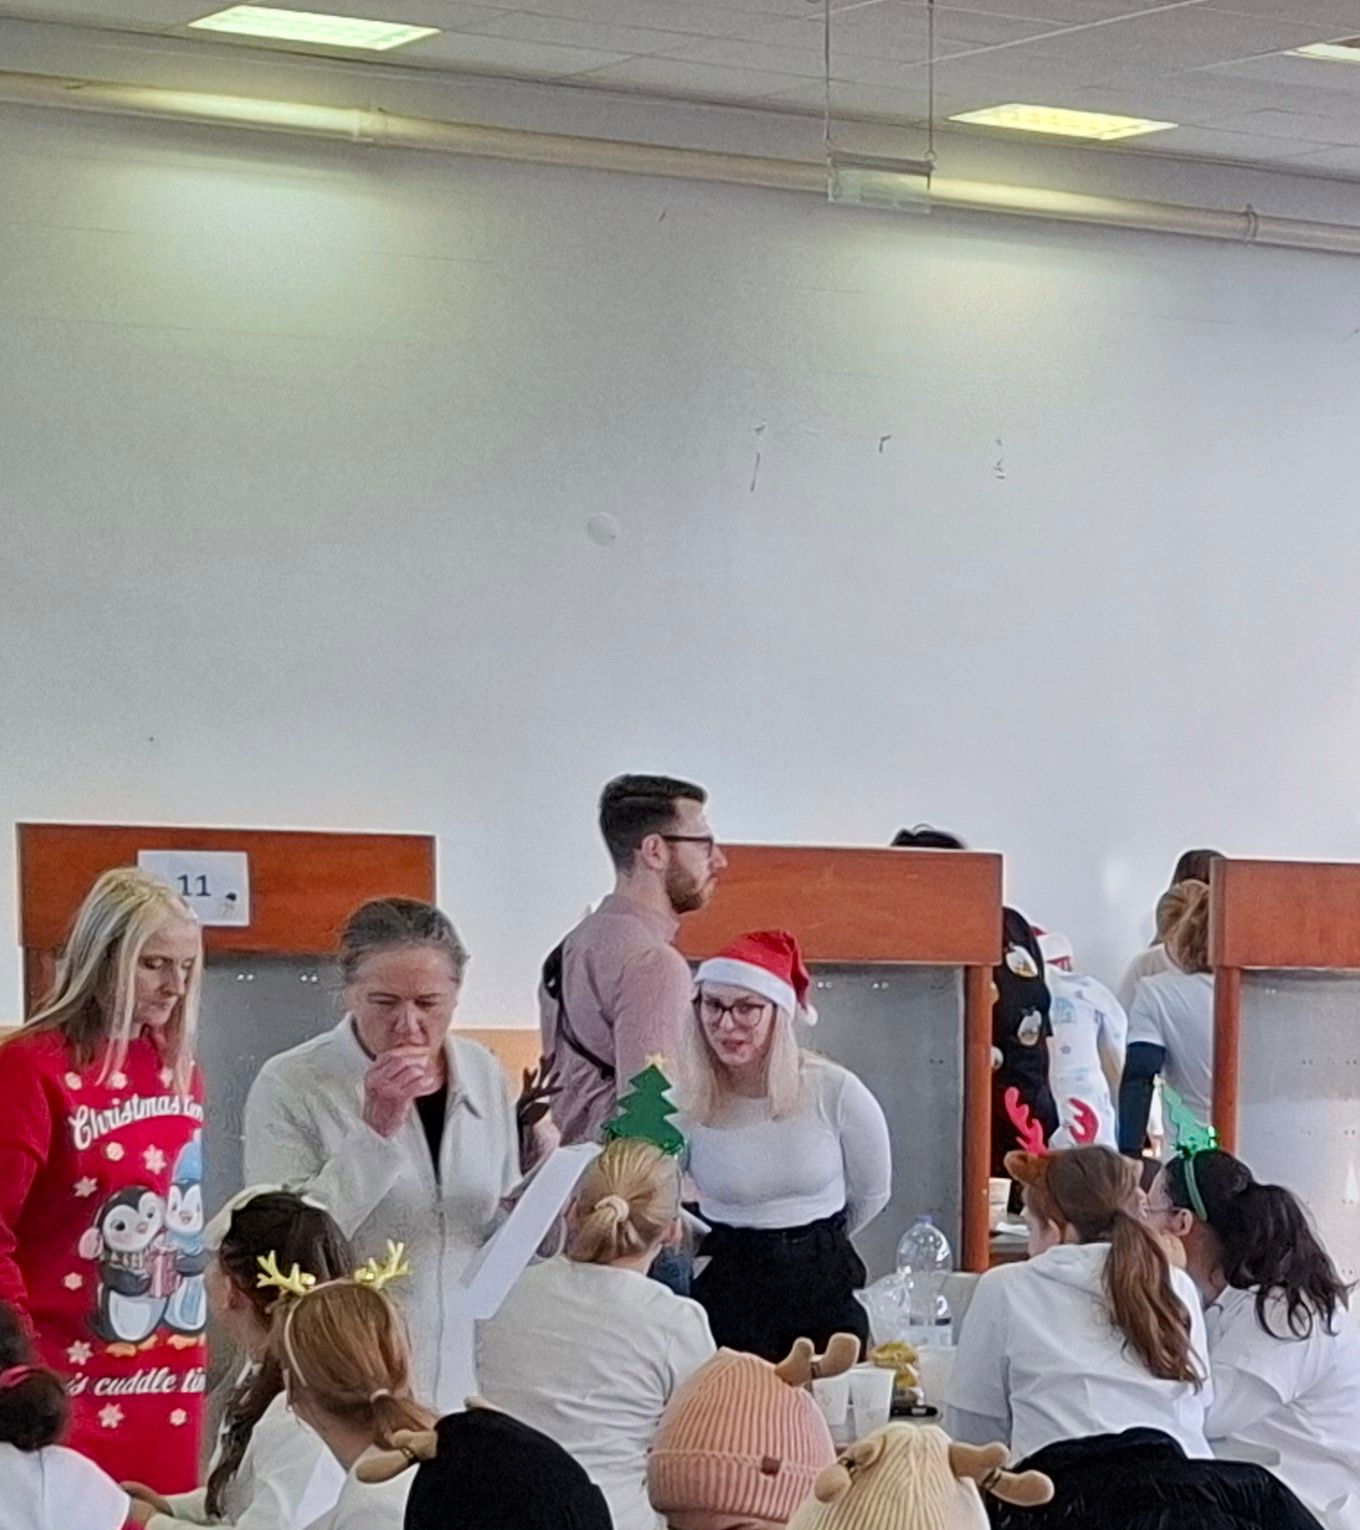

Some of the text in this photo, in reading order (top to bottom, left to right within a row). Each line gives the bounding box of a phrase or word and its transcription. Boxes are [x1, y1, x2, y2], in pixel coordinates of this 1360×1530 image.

[176, 873, 211, 897] 11
[68, 1093, 180, 1150] Christmas
[94, 1366, 177, 1396] cuddle
